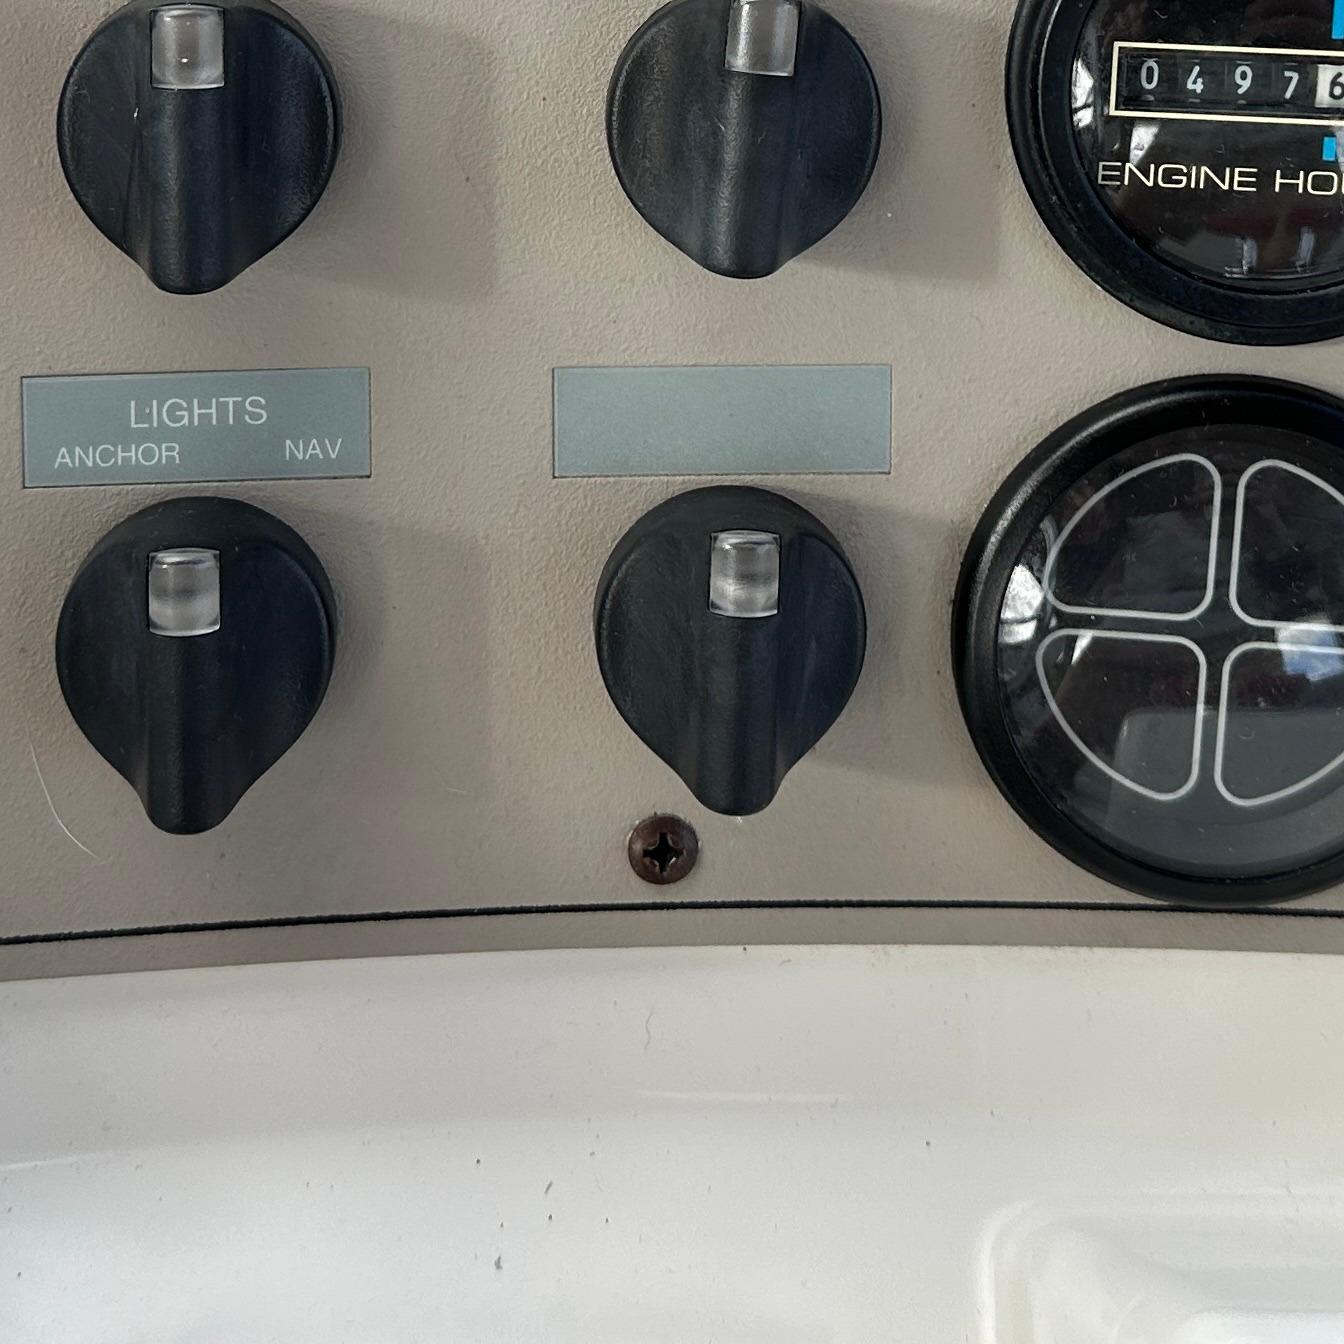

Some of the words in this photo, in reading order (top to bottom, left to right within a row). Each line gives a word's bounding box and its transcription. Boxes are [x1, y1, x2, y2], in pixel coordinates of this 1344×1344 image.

[1097, 161, 1258, 192] ENGINE
[130, 396, 268, 428] LIGHTS
[54, 443, 180, 469] ANCHOR
[285, 438, 343, 460] NAV
